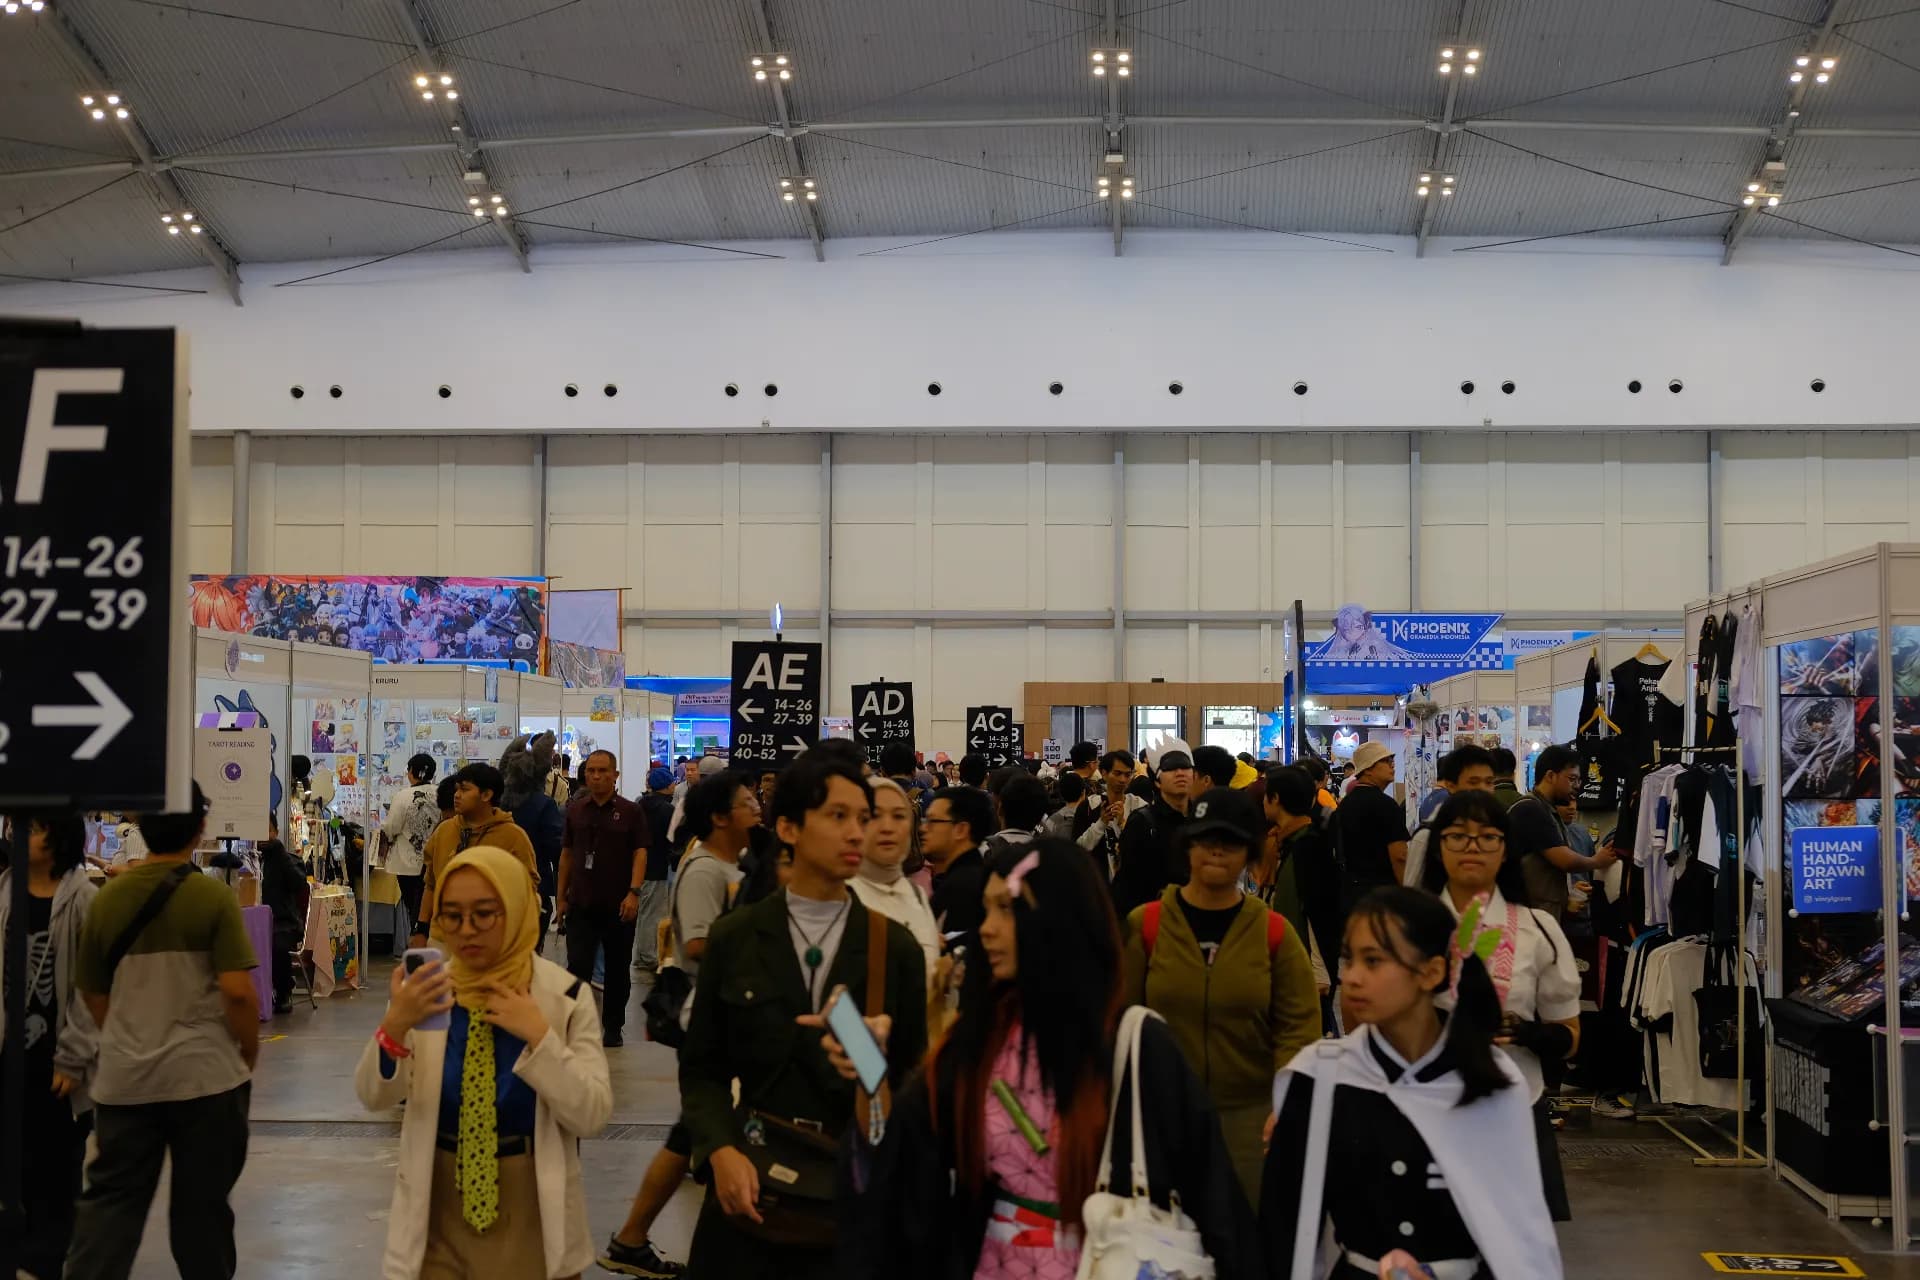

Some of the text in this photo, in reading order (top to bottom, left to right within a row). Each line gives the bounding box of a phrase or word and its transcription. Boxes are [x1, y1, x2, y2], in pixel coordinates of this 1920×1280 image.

[0, 367, 125, 504] F
[3, 536, 144, 578] 14-26
[0, 588, 148, 630] 27-39
[1409, 622, 1471, 634] PHOENIX
[742, 653, 809, 691] AE
[774, 699, 812, 711] 14-26
[858, 689, 905, 717] AD
[773, 713, 813, 725] 27-39
[882, 720, 909, 729] 14-26
[970, 712, 1007, 732] AC
[738, 734, 774, 746] 01-13
[882, 729, 910, 739] 27-39
[1011, 727, 1020, 743] B
[734, 748, 777, 760] 40-52
[1802, 841, 1862, 853] HUMAN
[1803, 853, 1855, 865] HAND-
[1803, 866, 1865, 877] DRAWN
[1803, 878, 1835, 890] ART
